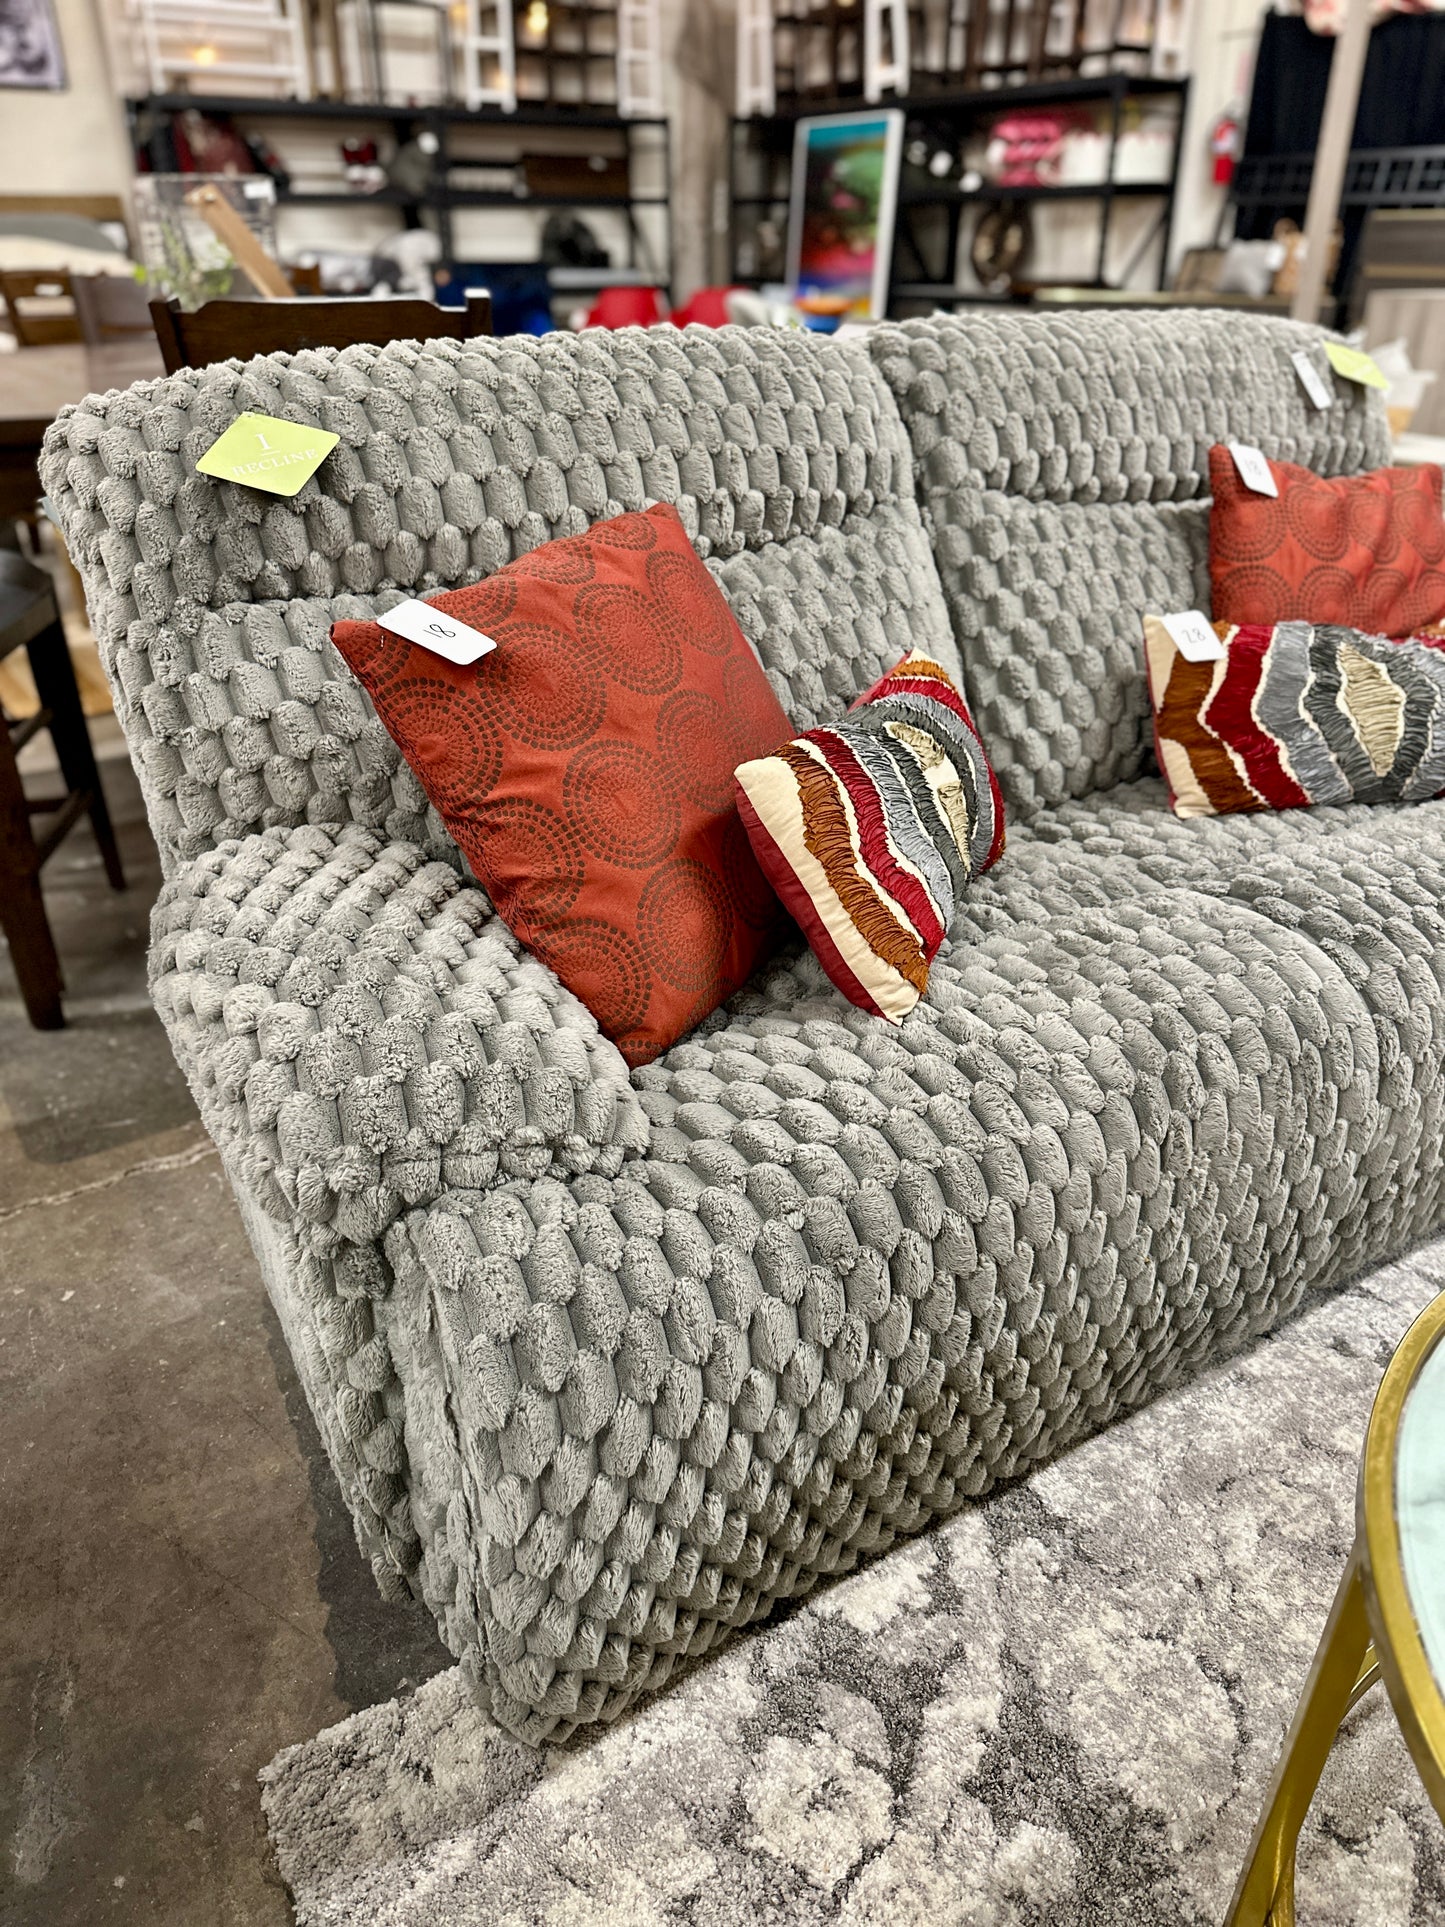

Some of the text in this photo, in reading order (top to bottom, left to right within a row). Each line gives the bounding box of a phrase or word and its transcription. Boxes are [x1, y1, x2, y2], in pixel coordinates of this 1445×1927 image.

[232, 448, 319, 477] RECLINE
[423, 623, 456, 638] 18
[1181, 628, 1206, 643] 28
